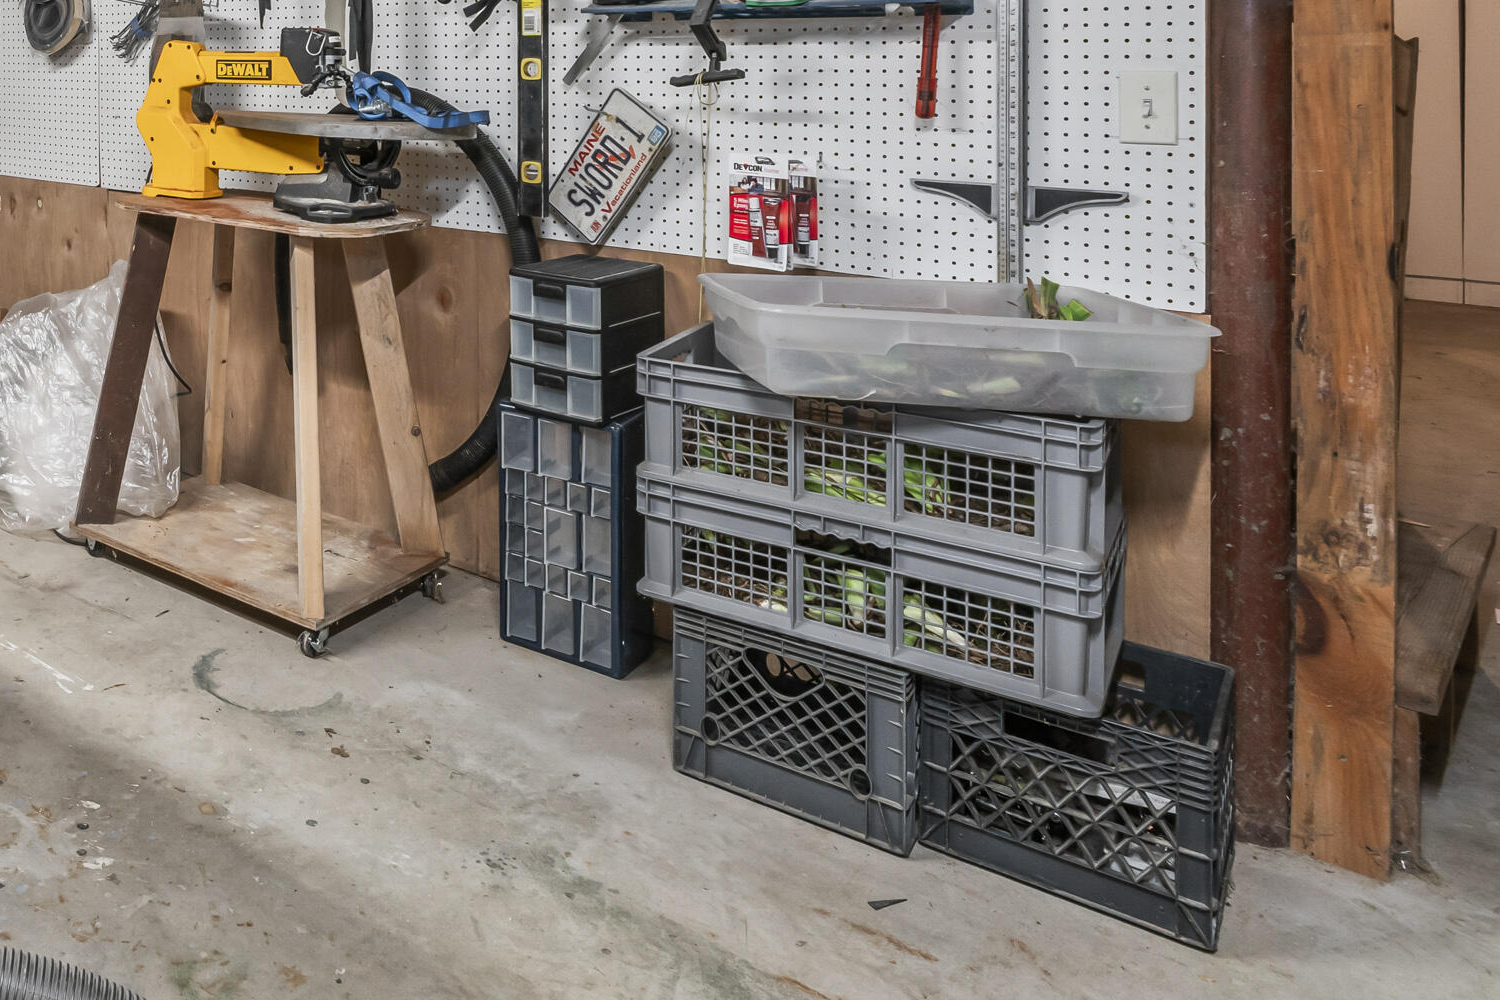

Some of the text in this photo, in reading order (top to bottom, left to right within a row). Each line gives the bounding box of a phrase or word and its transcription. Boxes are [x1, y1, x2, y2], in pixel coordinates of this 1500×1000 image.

[567, 122, 606, 177] MAINE
[734, 162, 762, 172] DEVCON
[601, 152, 647, 215] Vacationland
